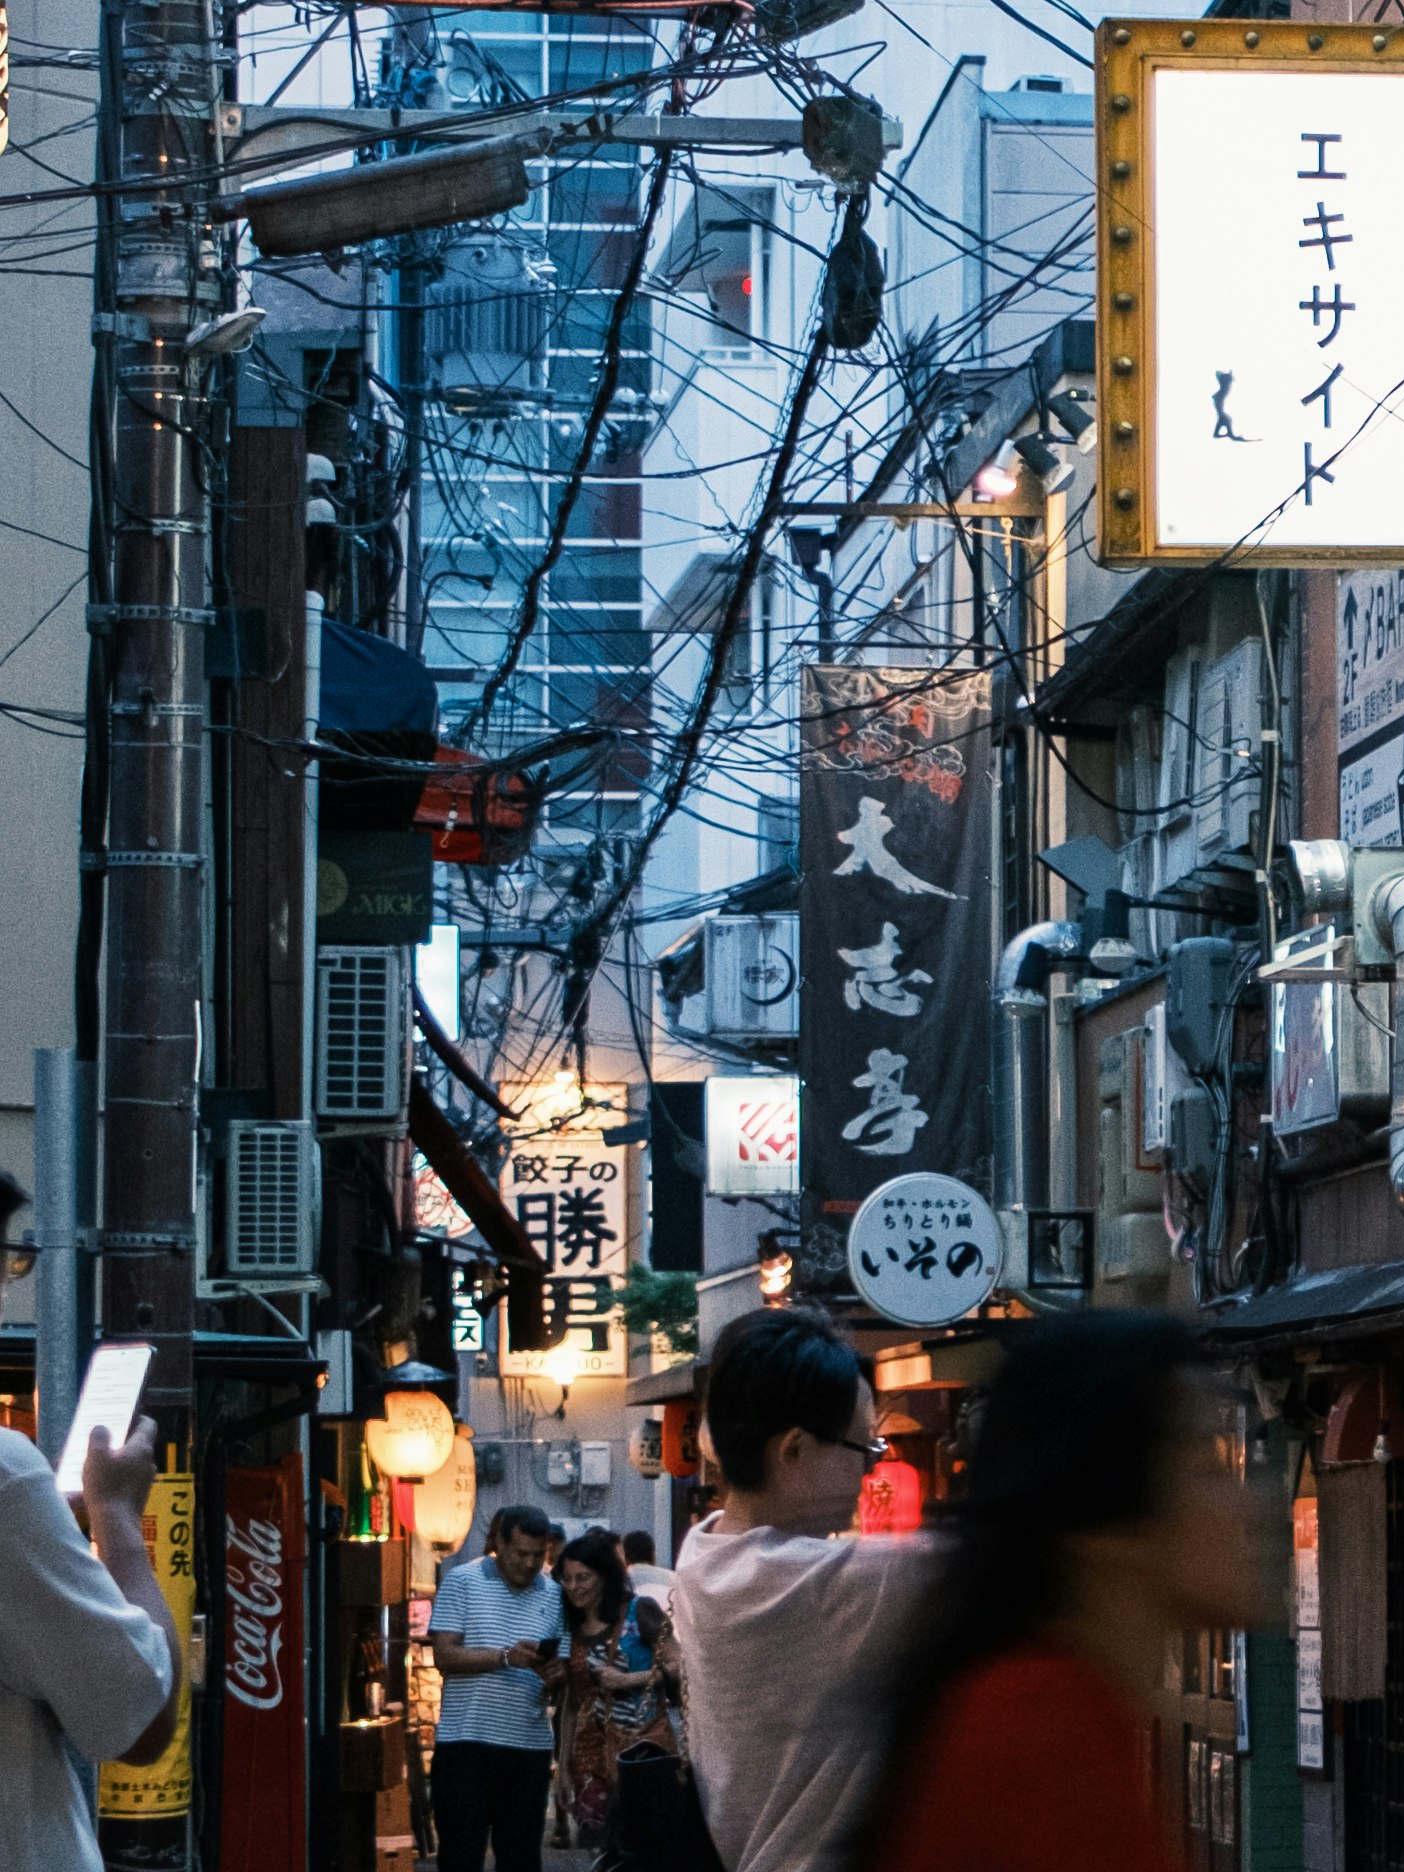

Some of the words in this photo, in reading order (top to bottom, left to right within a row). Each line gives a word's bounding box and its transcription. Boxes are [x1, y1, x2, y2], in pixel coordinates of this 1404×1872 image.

[1296, 133, 1355, 506] エキサイト
[512, 1155, 617, 1184] 餃子の
[861, 1236, 984, 1280] いその
